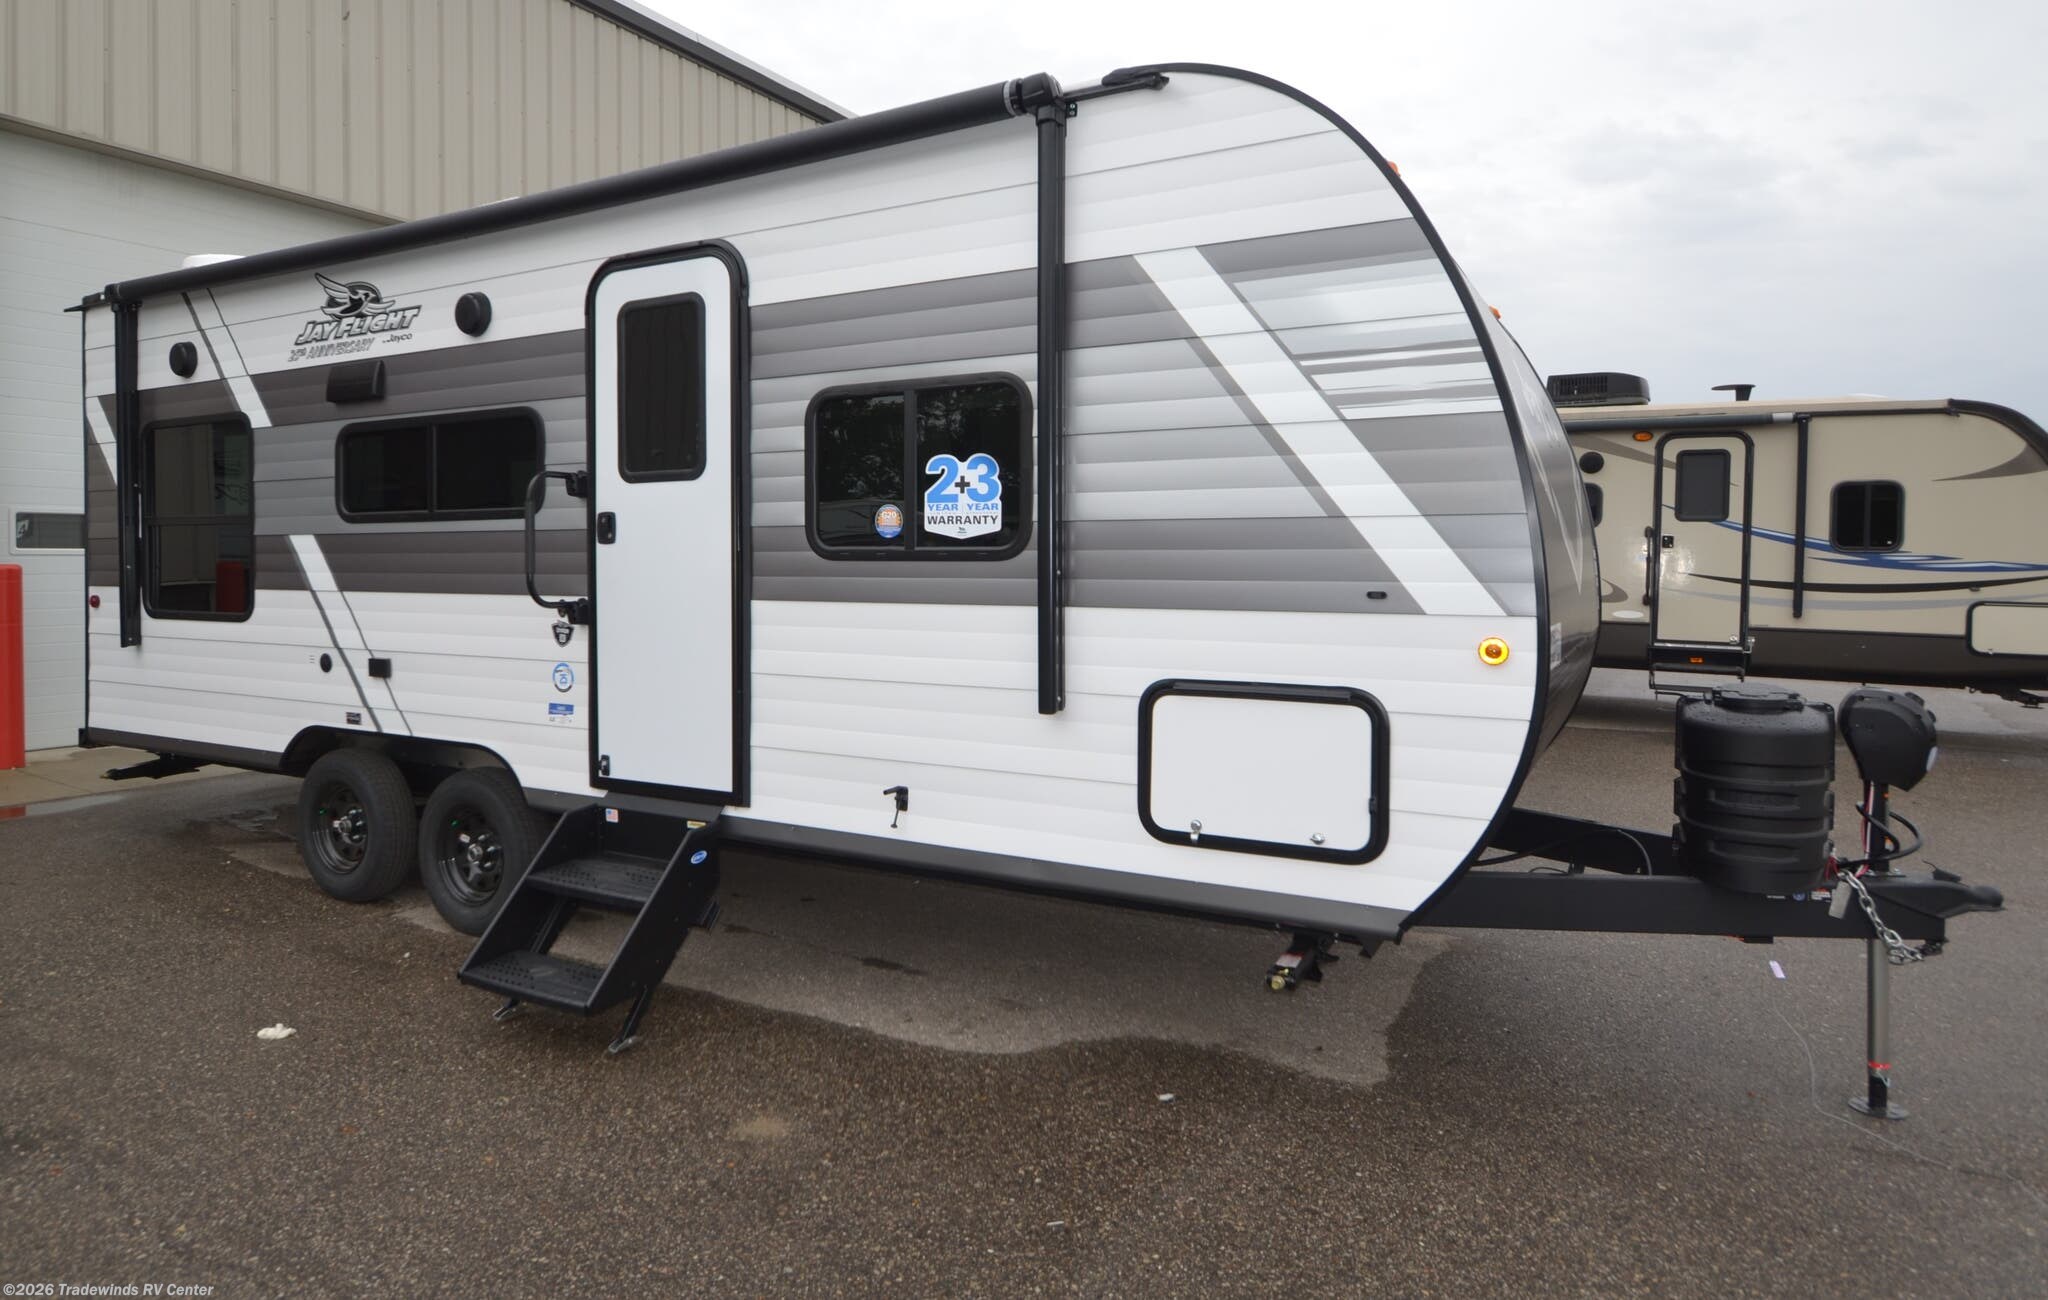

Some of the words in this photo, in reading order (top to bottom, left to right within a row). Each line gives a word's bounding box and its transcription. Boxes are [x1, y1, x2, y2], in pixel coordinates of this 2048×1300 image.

[927, 503, 959, 511] YEAR
[966, 502, 999, 511] YEAR
[927, 515, 999, 525] WARRANTY
